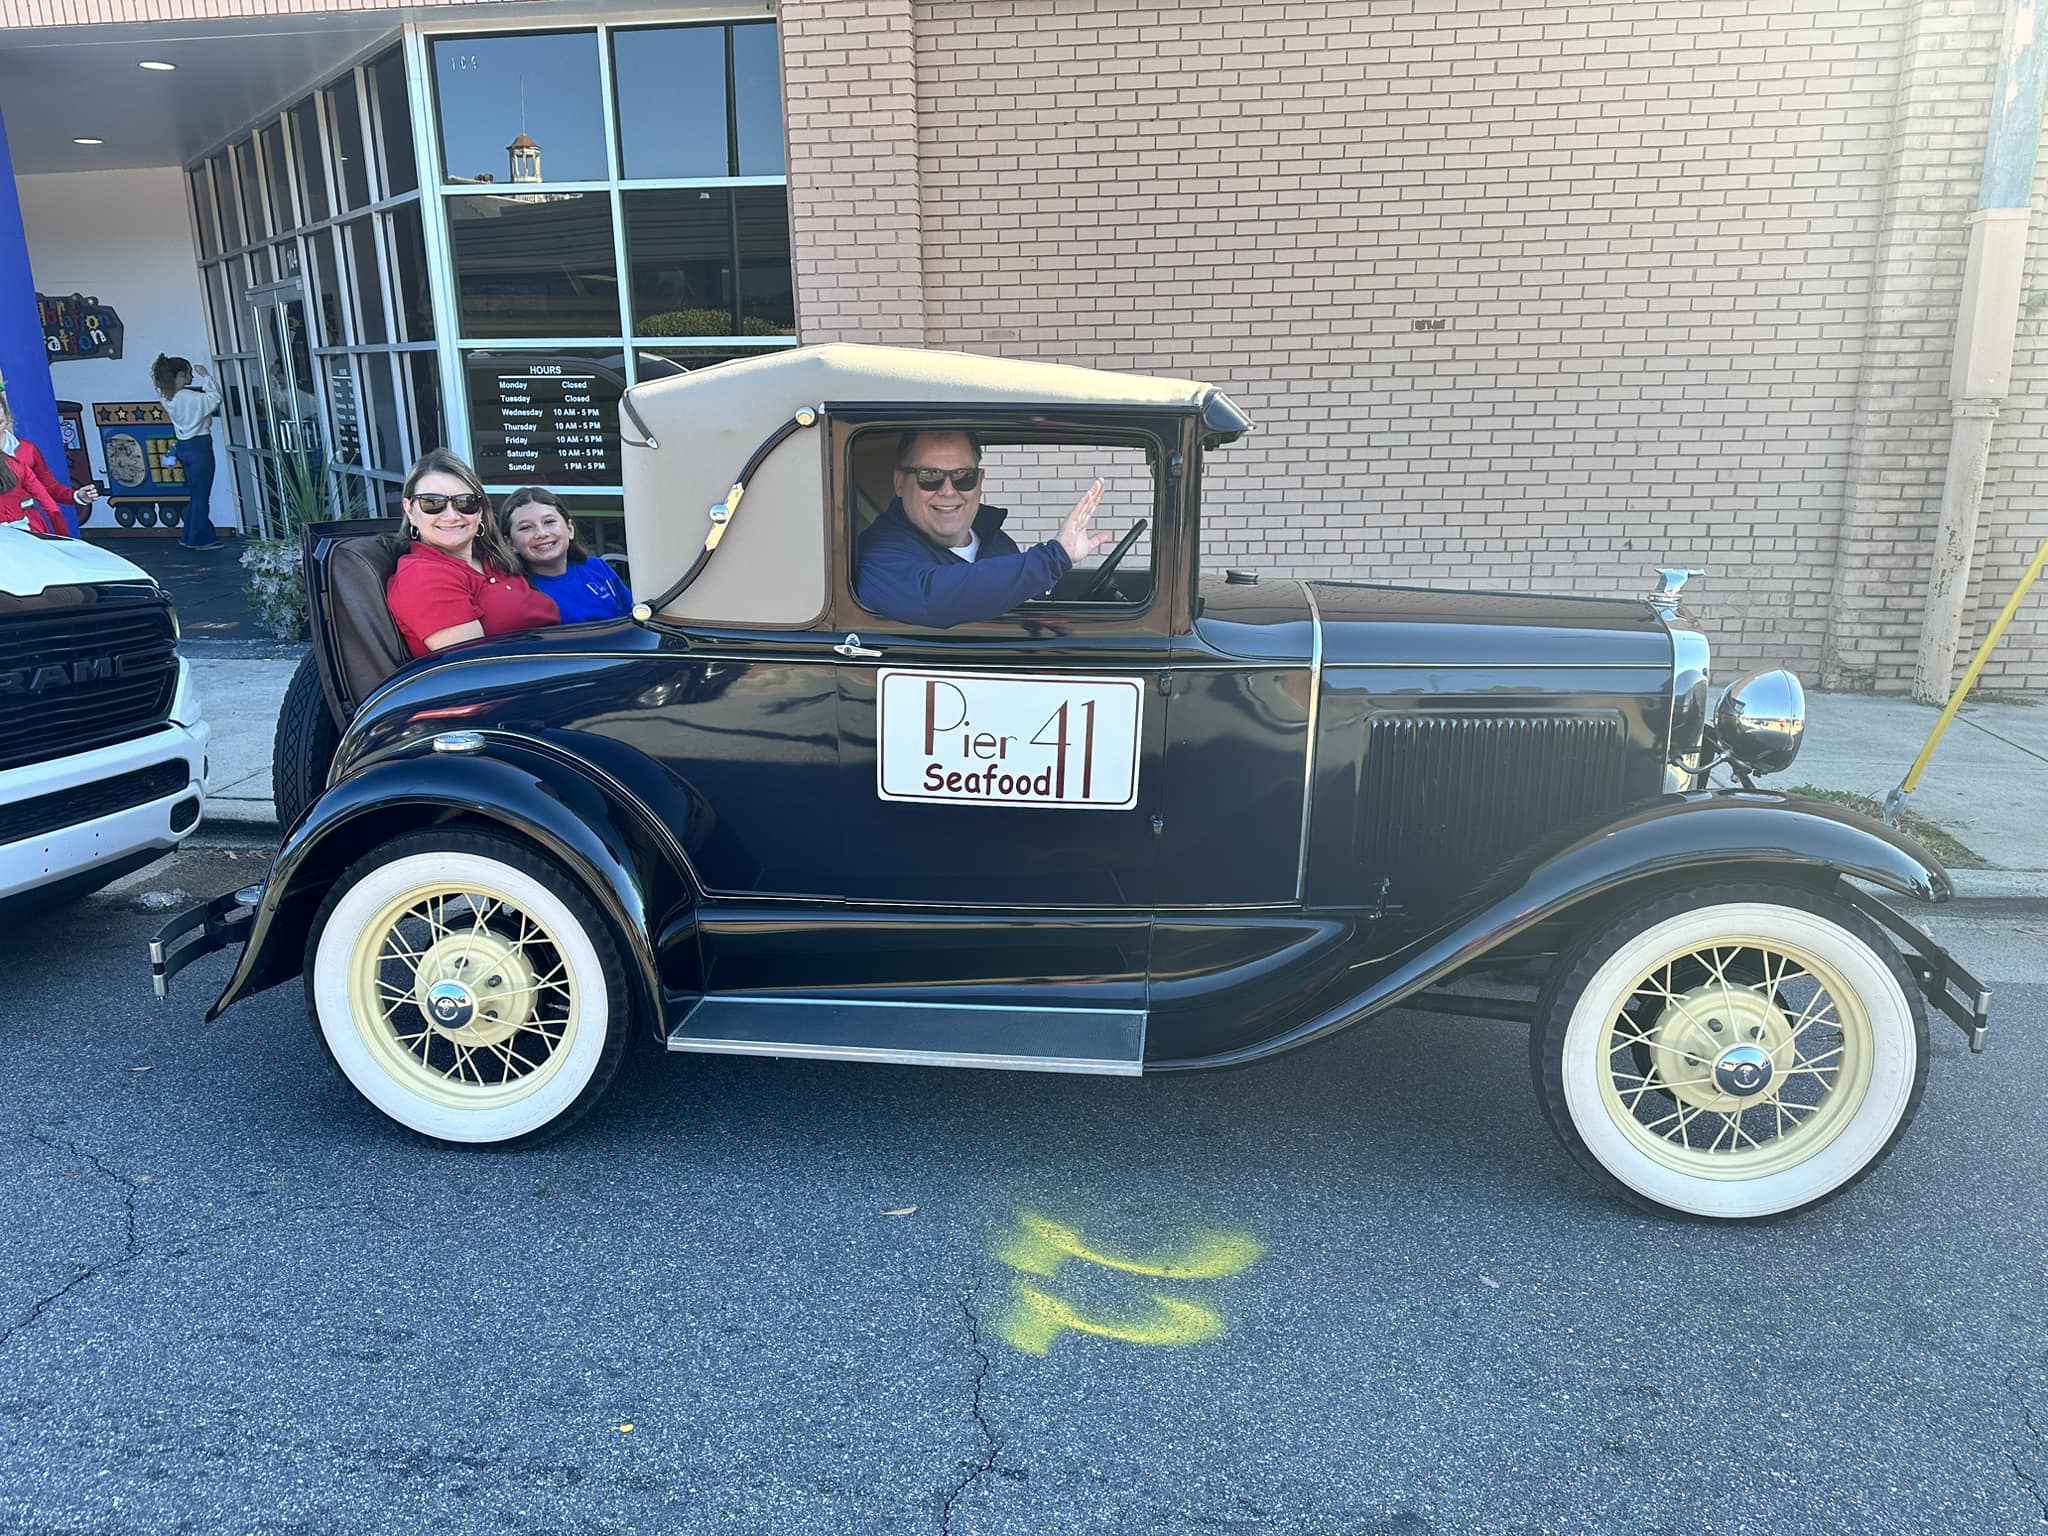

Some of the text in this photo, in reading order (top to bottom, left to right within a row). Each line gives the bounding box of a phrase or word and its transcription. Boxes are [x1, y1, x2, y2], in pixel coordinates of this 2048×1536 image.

[44, 327, 108, 353] ation
[529, 366, 562, 375] HOURS
[499, 381, 588, 390] Monday Closed
[500, 395, 590, 404] Tuesday Closed
[501, 408, 543, 417] Wednesday
[503, 423, 537, 432] Thursday
[554, 422, 564, 430] 10
[565, 422, 577, 430] AM
[583, 422, 587, 430] 5
[589, 422, 600, 430] PM
[505, 436, 528, 445] Friday
[556, 435, 566, 443] 10
[567, 435, 579, 443] AM
[585, 435, 589, 443] 5
[590, 435, 602, 443] PM
[506, 450, 539, 459] Saturday
[558, 449, 567, 457] 10
[568, 449, 580, 457] AM
[586, 449, 591, 457] 5
[592, 449, 604, 457] PM
[508, 463, 535, 472] Sunday
[0, 655, 112, 694] RAM
[924, 680, 1095, 799] Pier 41
[923, 763, 1052, 796] Seafood
